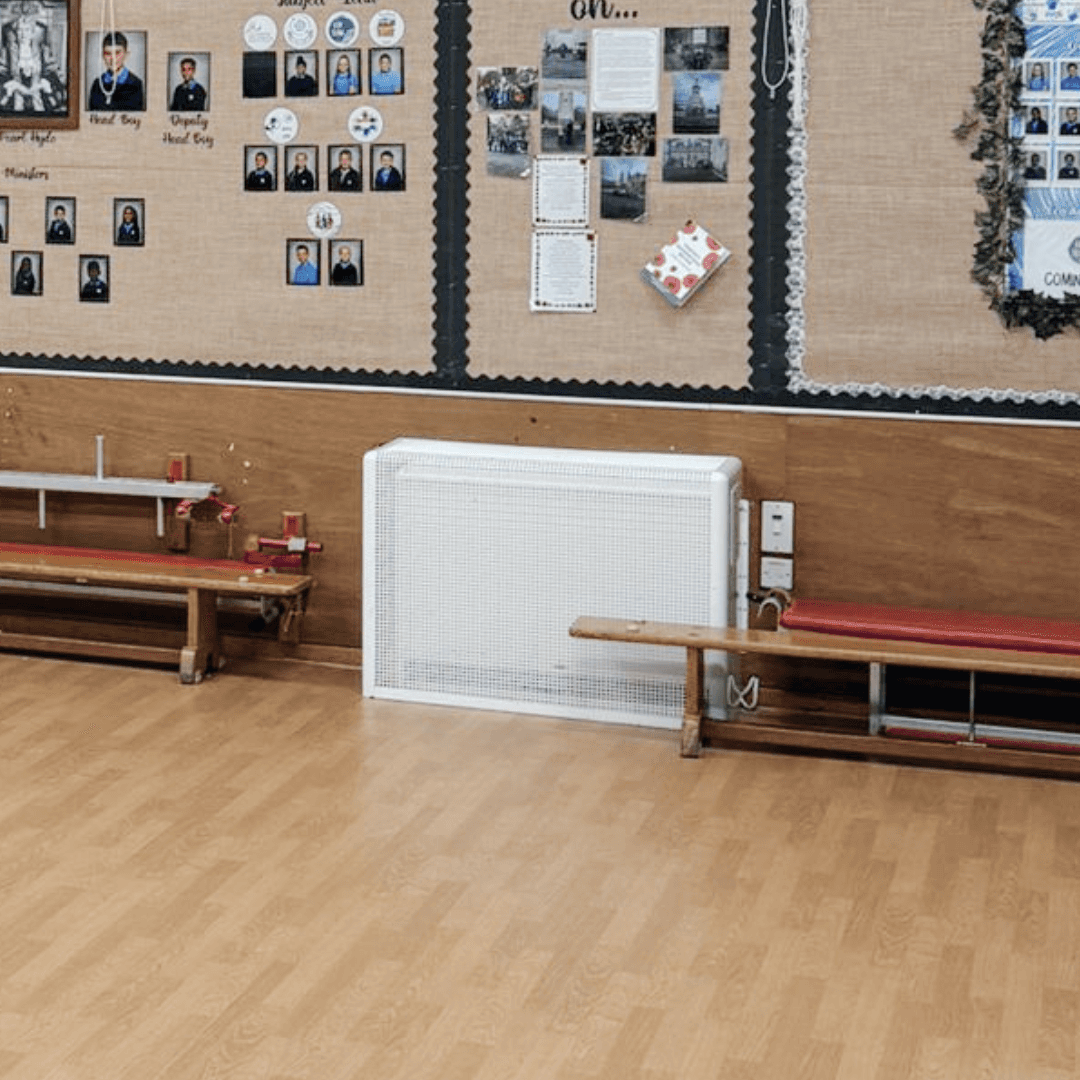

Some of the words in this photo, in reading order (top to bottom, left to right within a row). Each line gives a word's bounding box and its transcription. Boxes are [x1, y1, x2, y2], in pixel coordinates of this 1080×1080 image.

[89, 113, 114, 126] Head
[119, 114, 142, 129] Boy
[170, 114, 209, 130] Deputy
[162, 132, 190, 146] Head
[192, 133, 215, 149] Boy
[3, 166, 50, 181] Ministers
